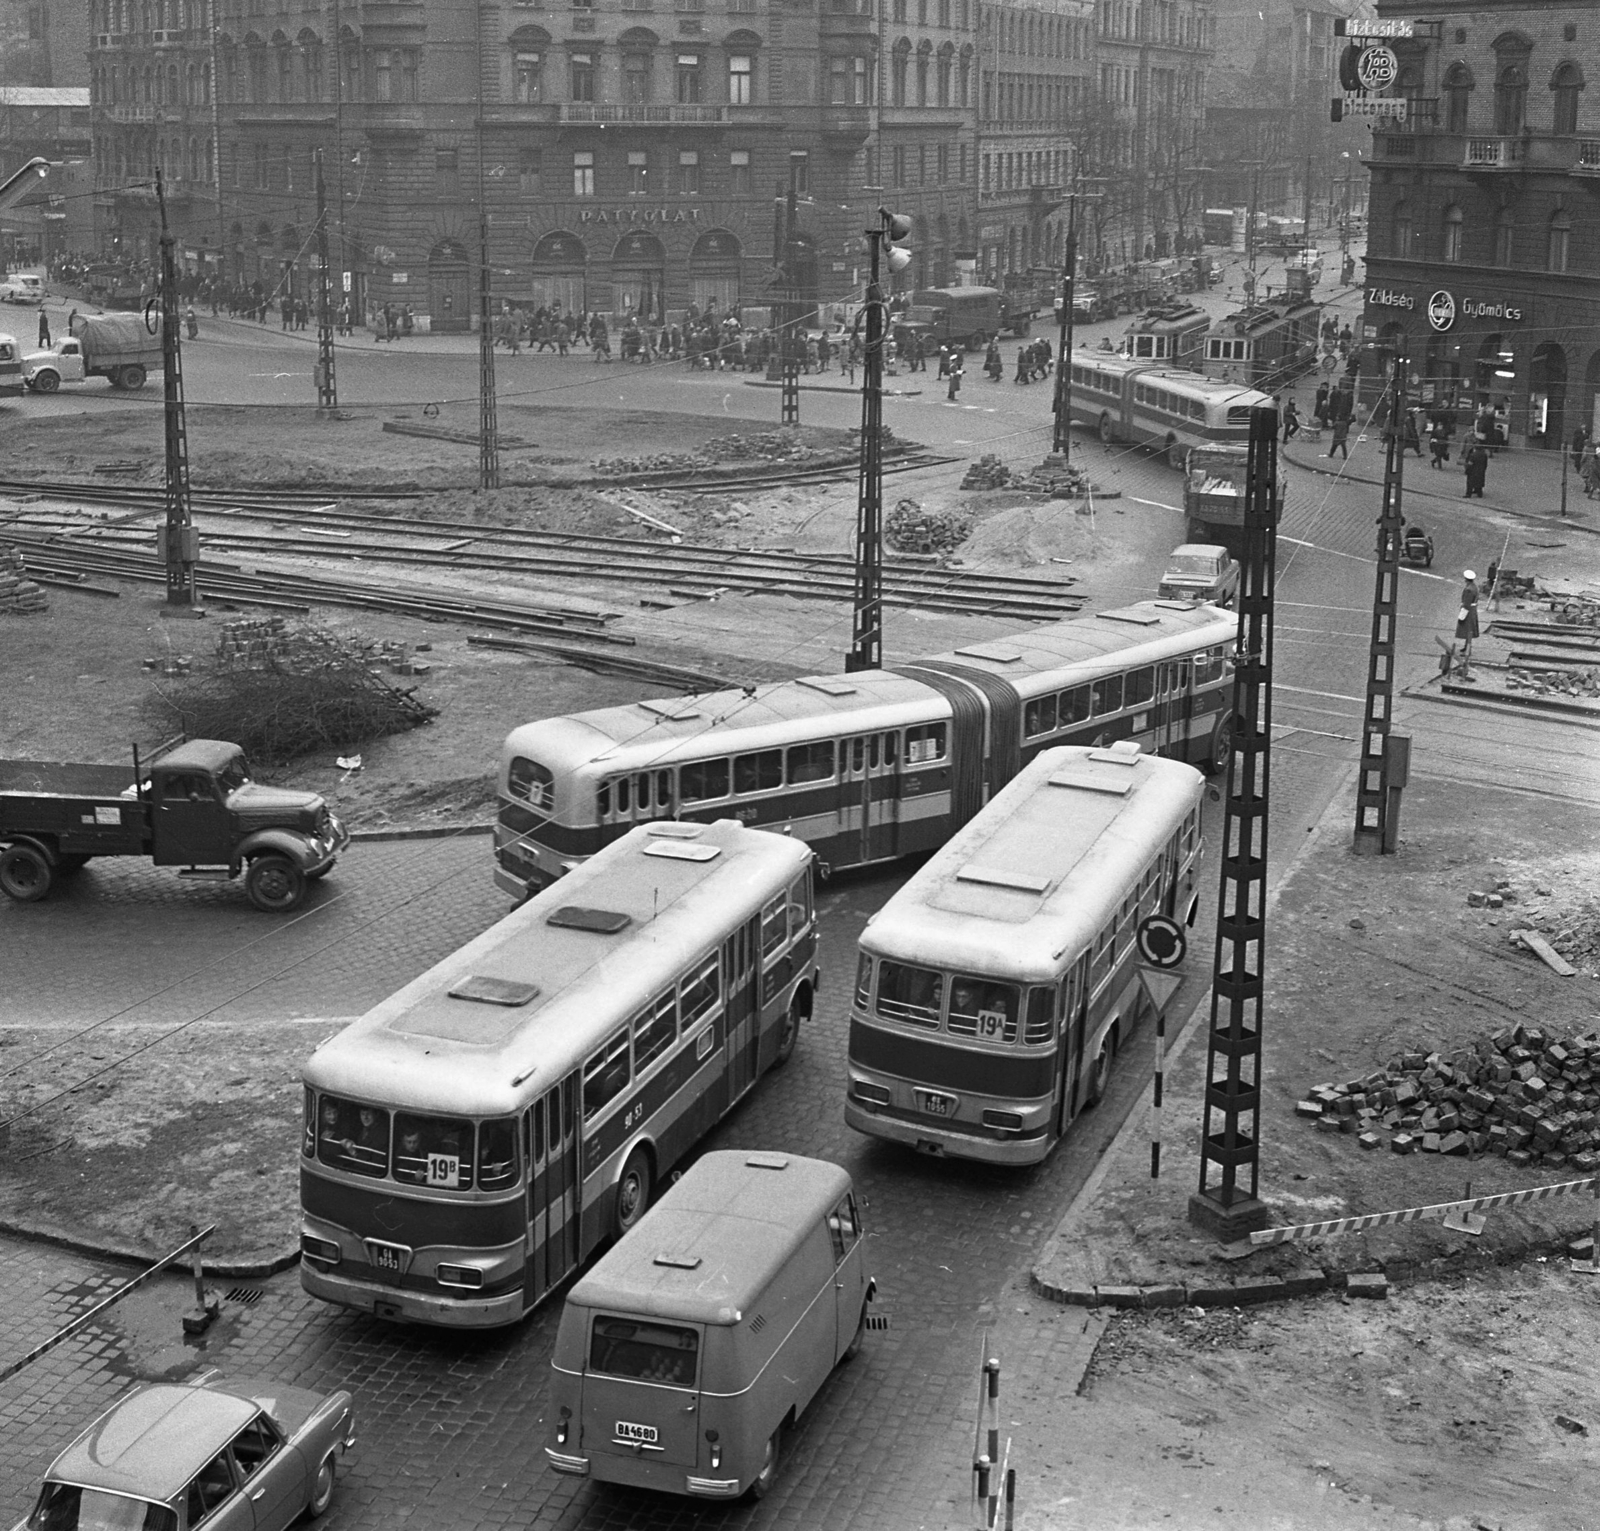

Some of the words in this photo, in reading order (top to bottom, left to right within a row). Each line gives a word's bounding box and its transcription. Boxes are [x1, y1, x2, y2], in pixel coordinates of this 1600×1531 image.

[580, 208, 700, 222] PATYOLAT
[1369, 288, 1414, 310] Zöldség
[1463, 298, 1521, 320] Gyümölcs
